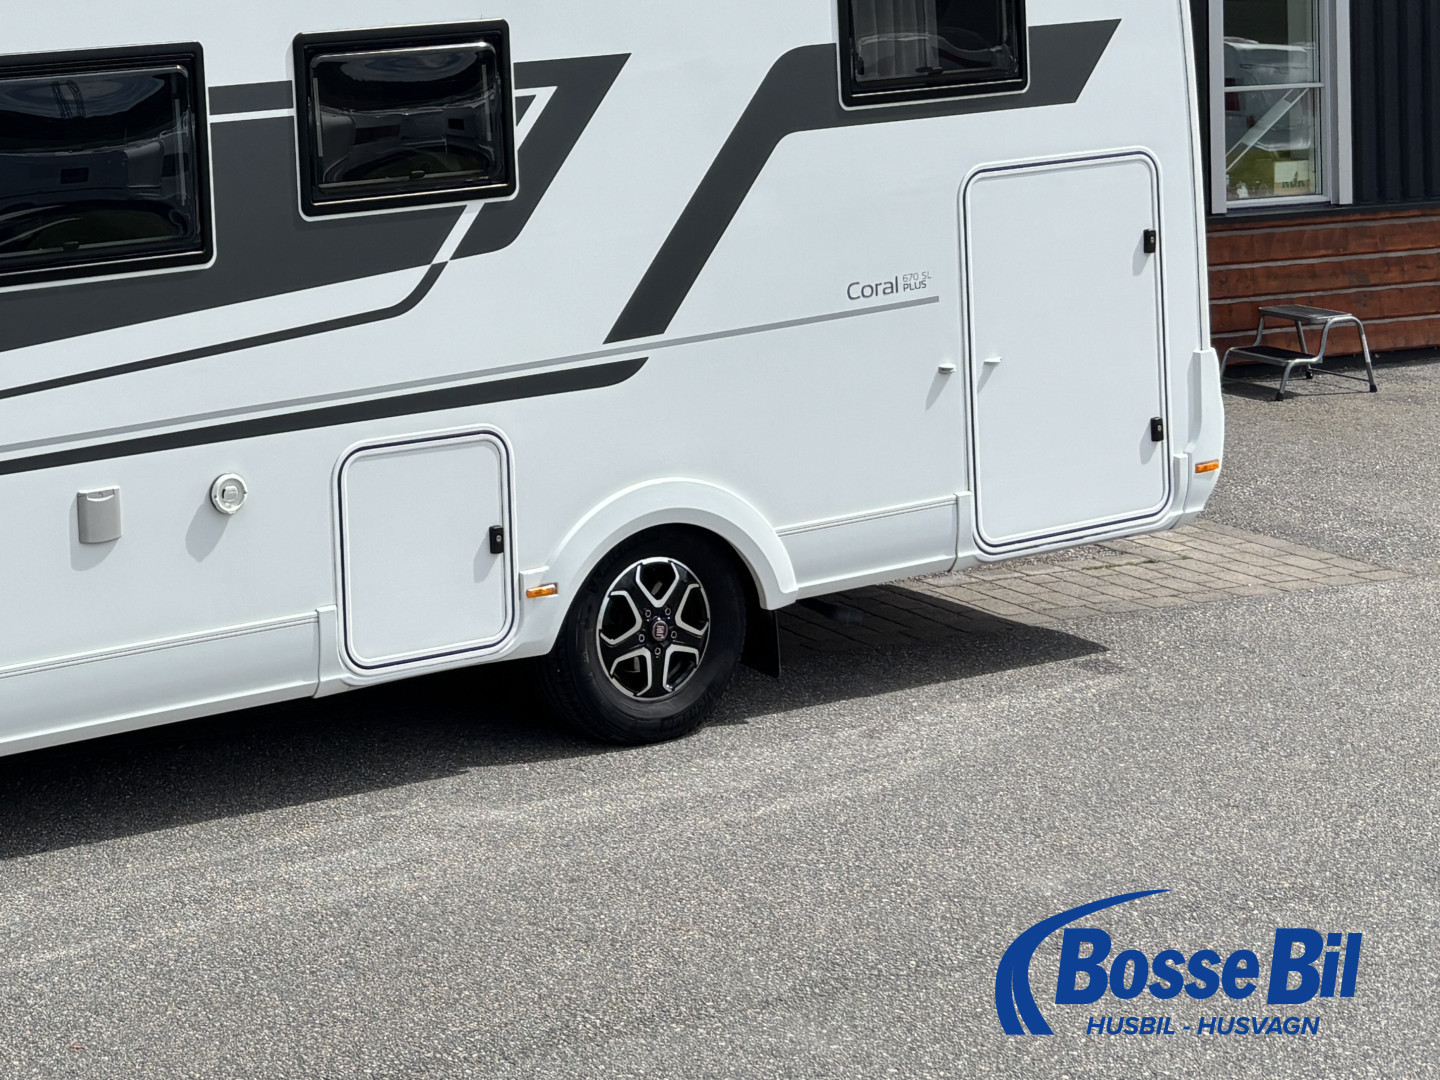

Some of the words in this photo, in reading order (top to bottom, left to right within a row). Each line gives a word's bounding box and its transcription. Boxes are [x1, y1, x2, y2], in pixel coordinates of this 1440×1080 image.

[846, 276, 899, 300] Coral
[902, 273, 919, 283] 670
[921, 271, 932, 280] SL
[903, 280, 927, 292] PLUS
